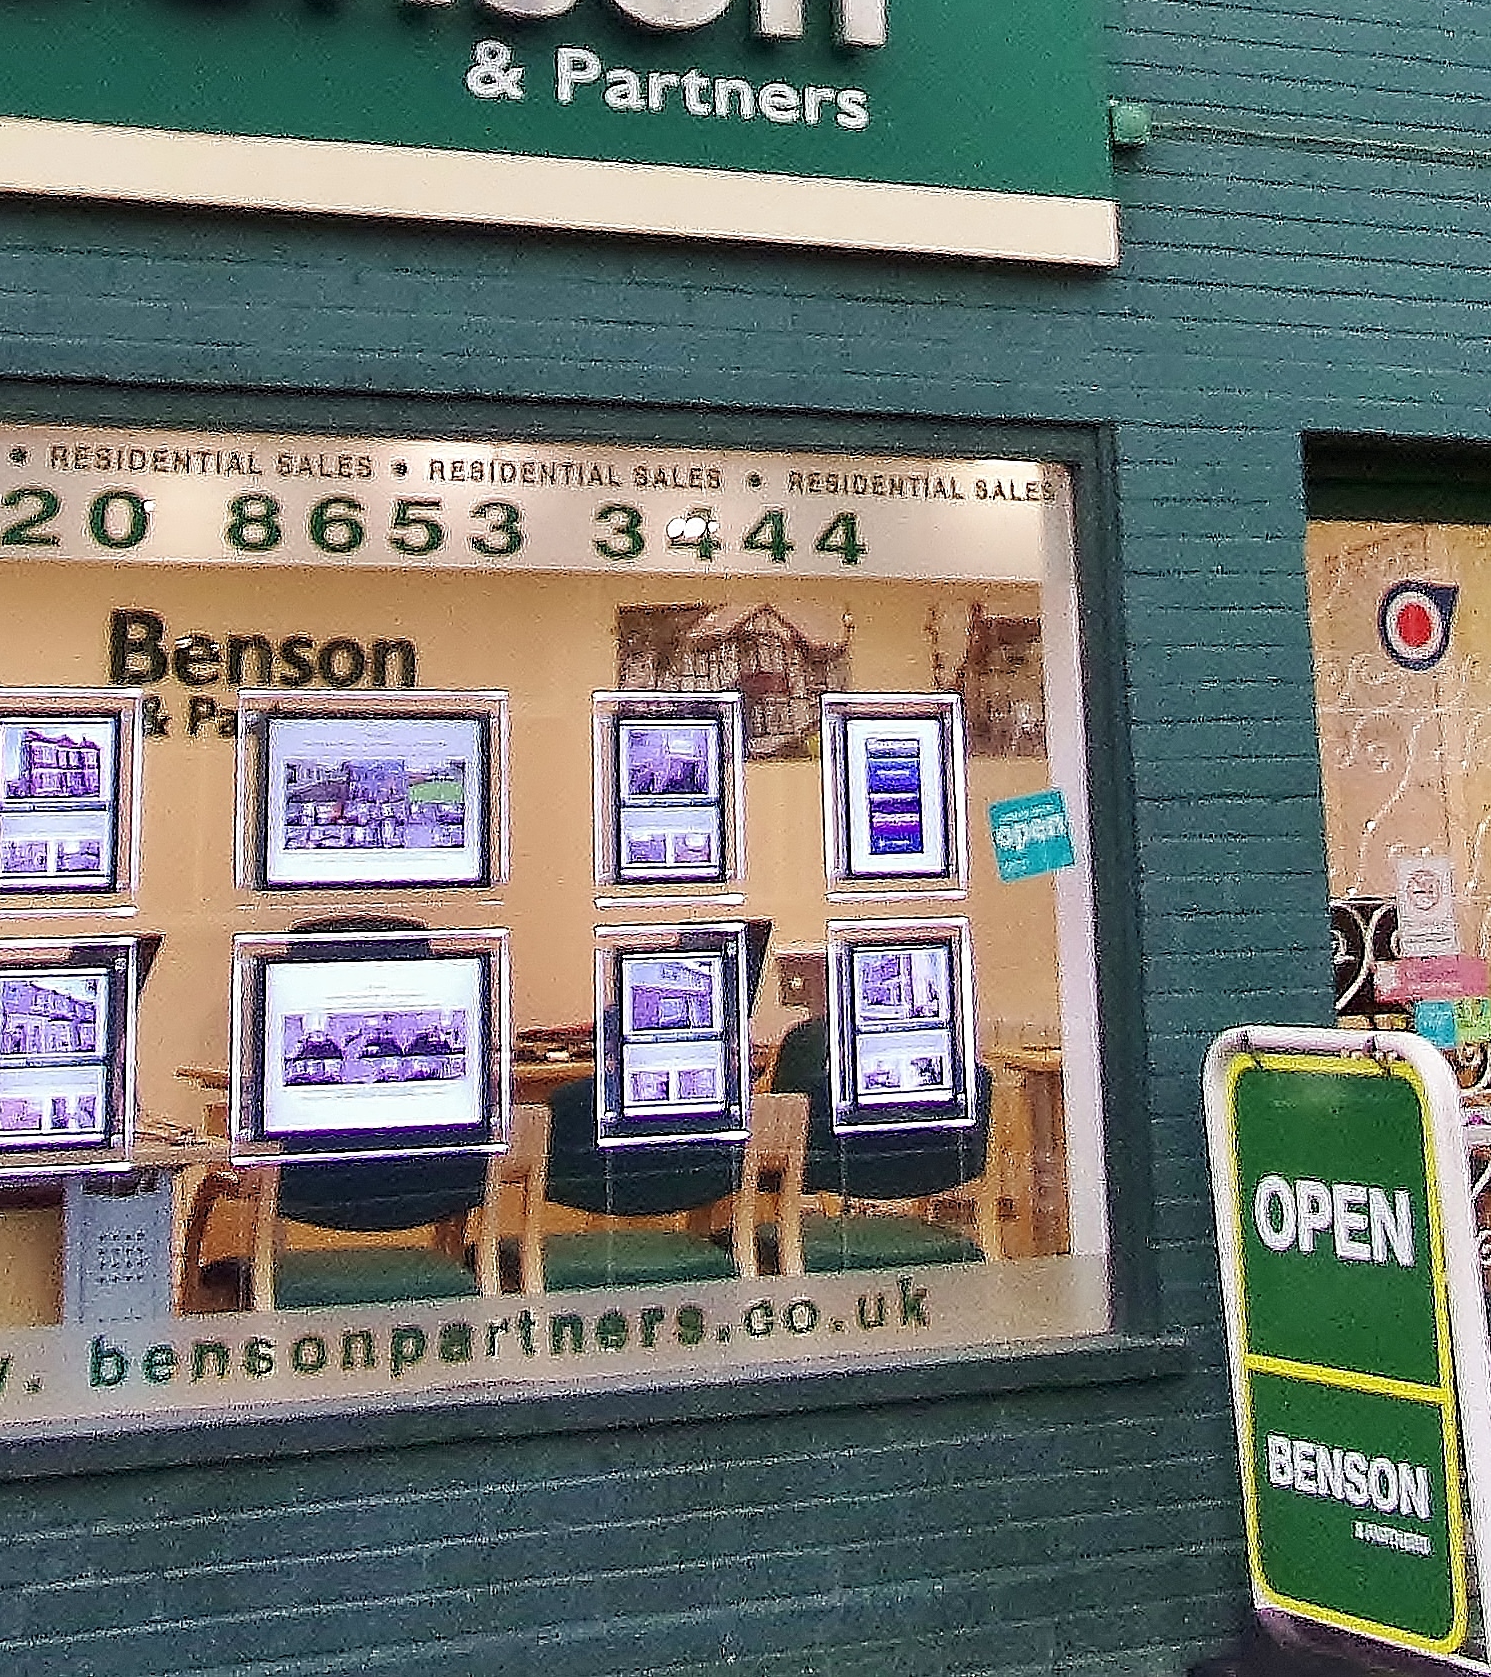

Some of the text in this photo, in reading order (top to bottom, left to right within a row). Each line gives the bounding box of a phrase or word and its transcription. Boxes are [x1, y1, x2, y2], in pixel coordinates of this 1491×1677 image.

[465, 39, 872, 131] & Partners
[49, 443, 263, 478] RESIDENTIAL
[276, 448, 374, 483] SALES
[427, 458, 621, 489] RESIDENTIAL
[634, 464, 722, 492] SALES
[788, 470, 963, 501] RESIDENTIAL
[975, 478, 1057, 503] SALES
[227, 489, 525, 559] 8653
[595, 501, 868, 567] 3444
[109, 606, 419, 688] Benson
[996, 813, 1065, 852] open
[1253, 1174, 1416, 1268] OPEN
[1264, 1431, 1432, 1521] BENSON
